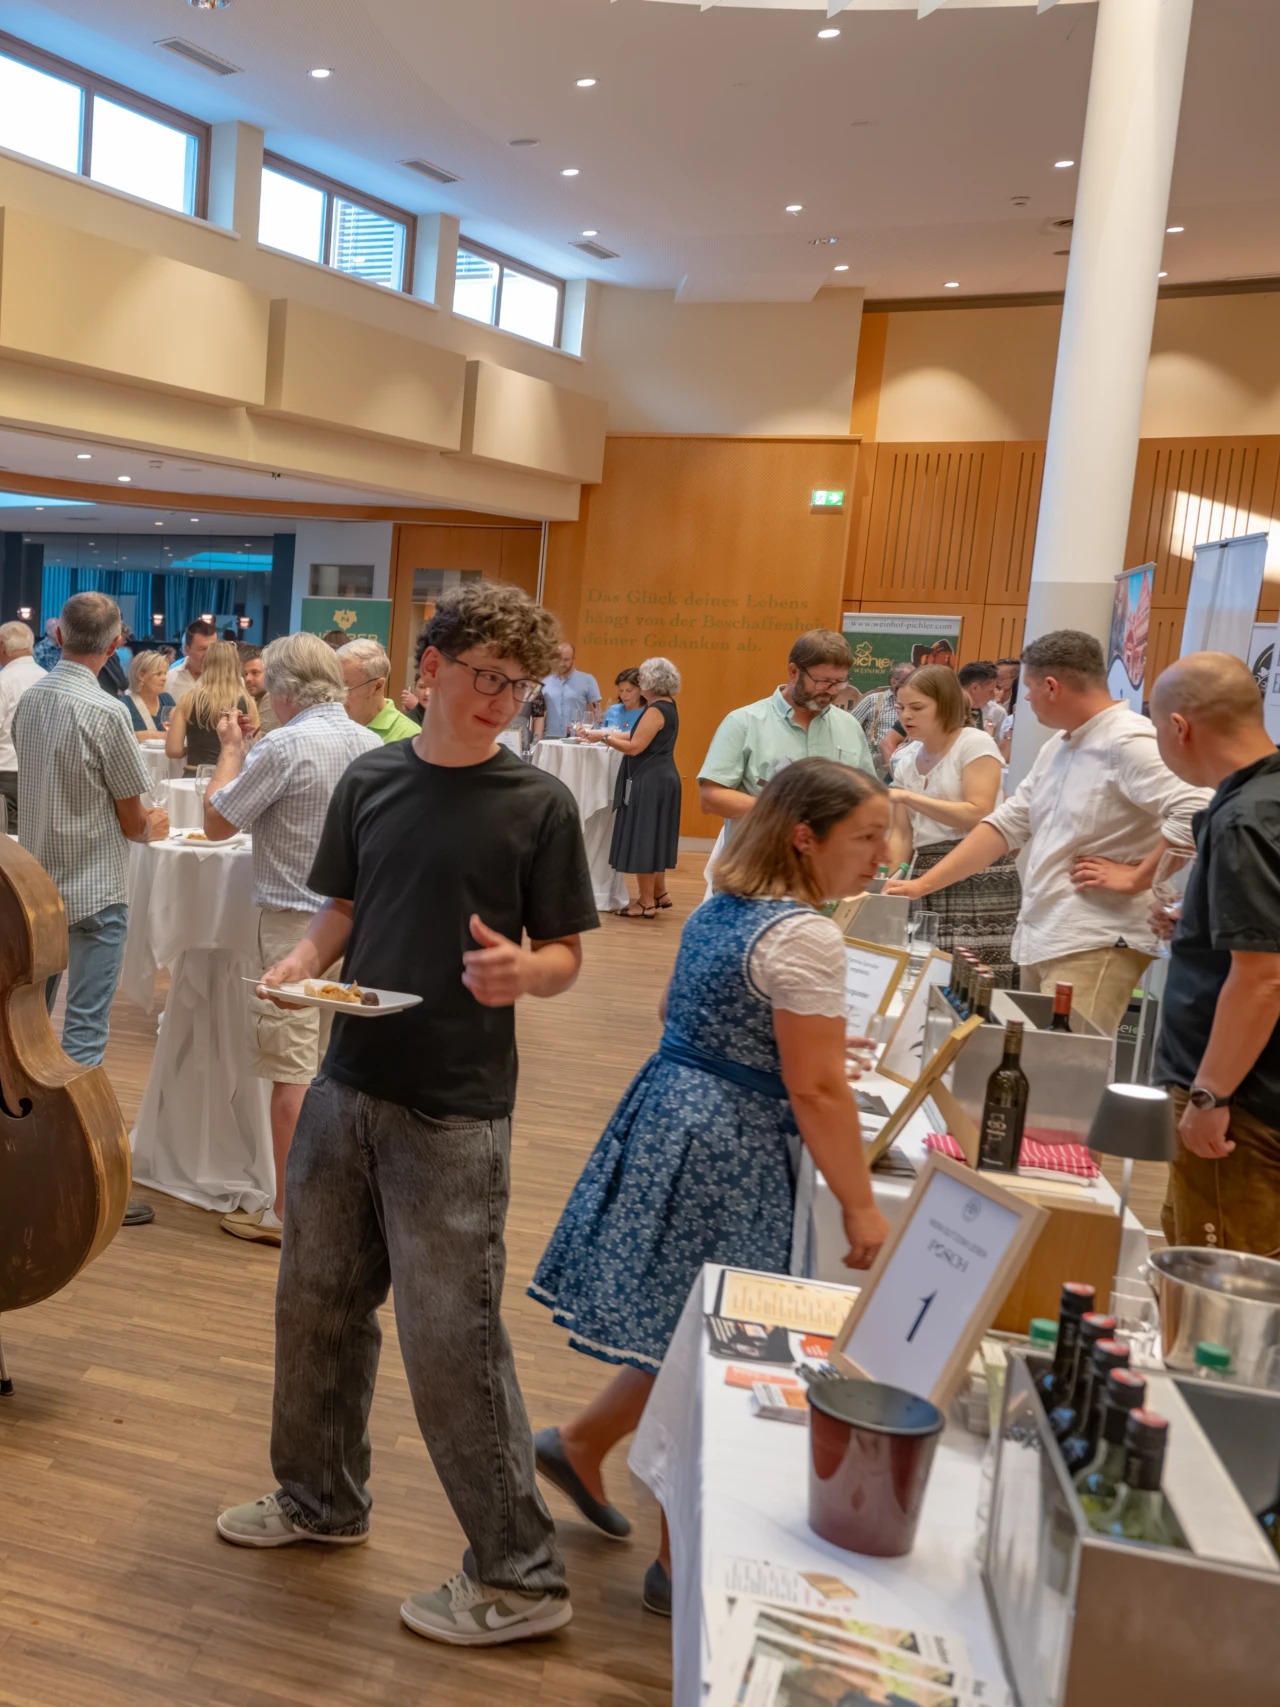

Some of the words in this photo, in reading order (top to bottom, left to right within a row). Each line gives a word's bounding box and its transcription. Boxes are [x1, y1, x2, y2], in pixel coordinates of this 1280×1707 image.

[587, 588, 620, 604] Das
[626, 589, 677, 606] Glück
[683, 591, 739, 608] deines
[746, 594, 809, 610] Lebens
[584, 609, 630, 629] hängt
[635, 615, 664, 627] von
[669, 612, 697, 628] der
[850, 620, 953, 630] www.weinhof-pichler.com
[582, 632, 638, 647] deiner
[643, 634, 730, 650] Gedanken
[853, 667, 887, 675] WEINHOF
[906, 1288, 939, 1343] 1
